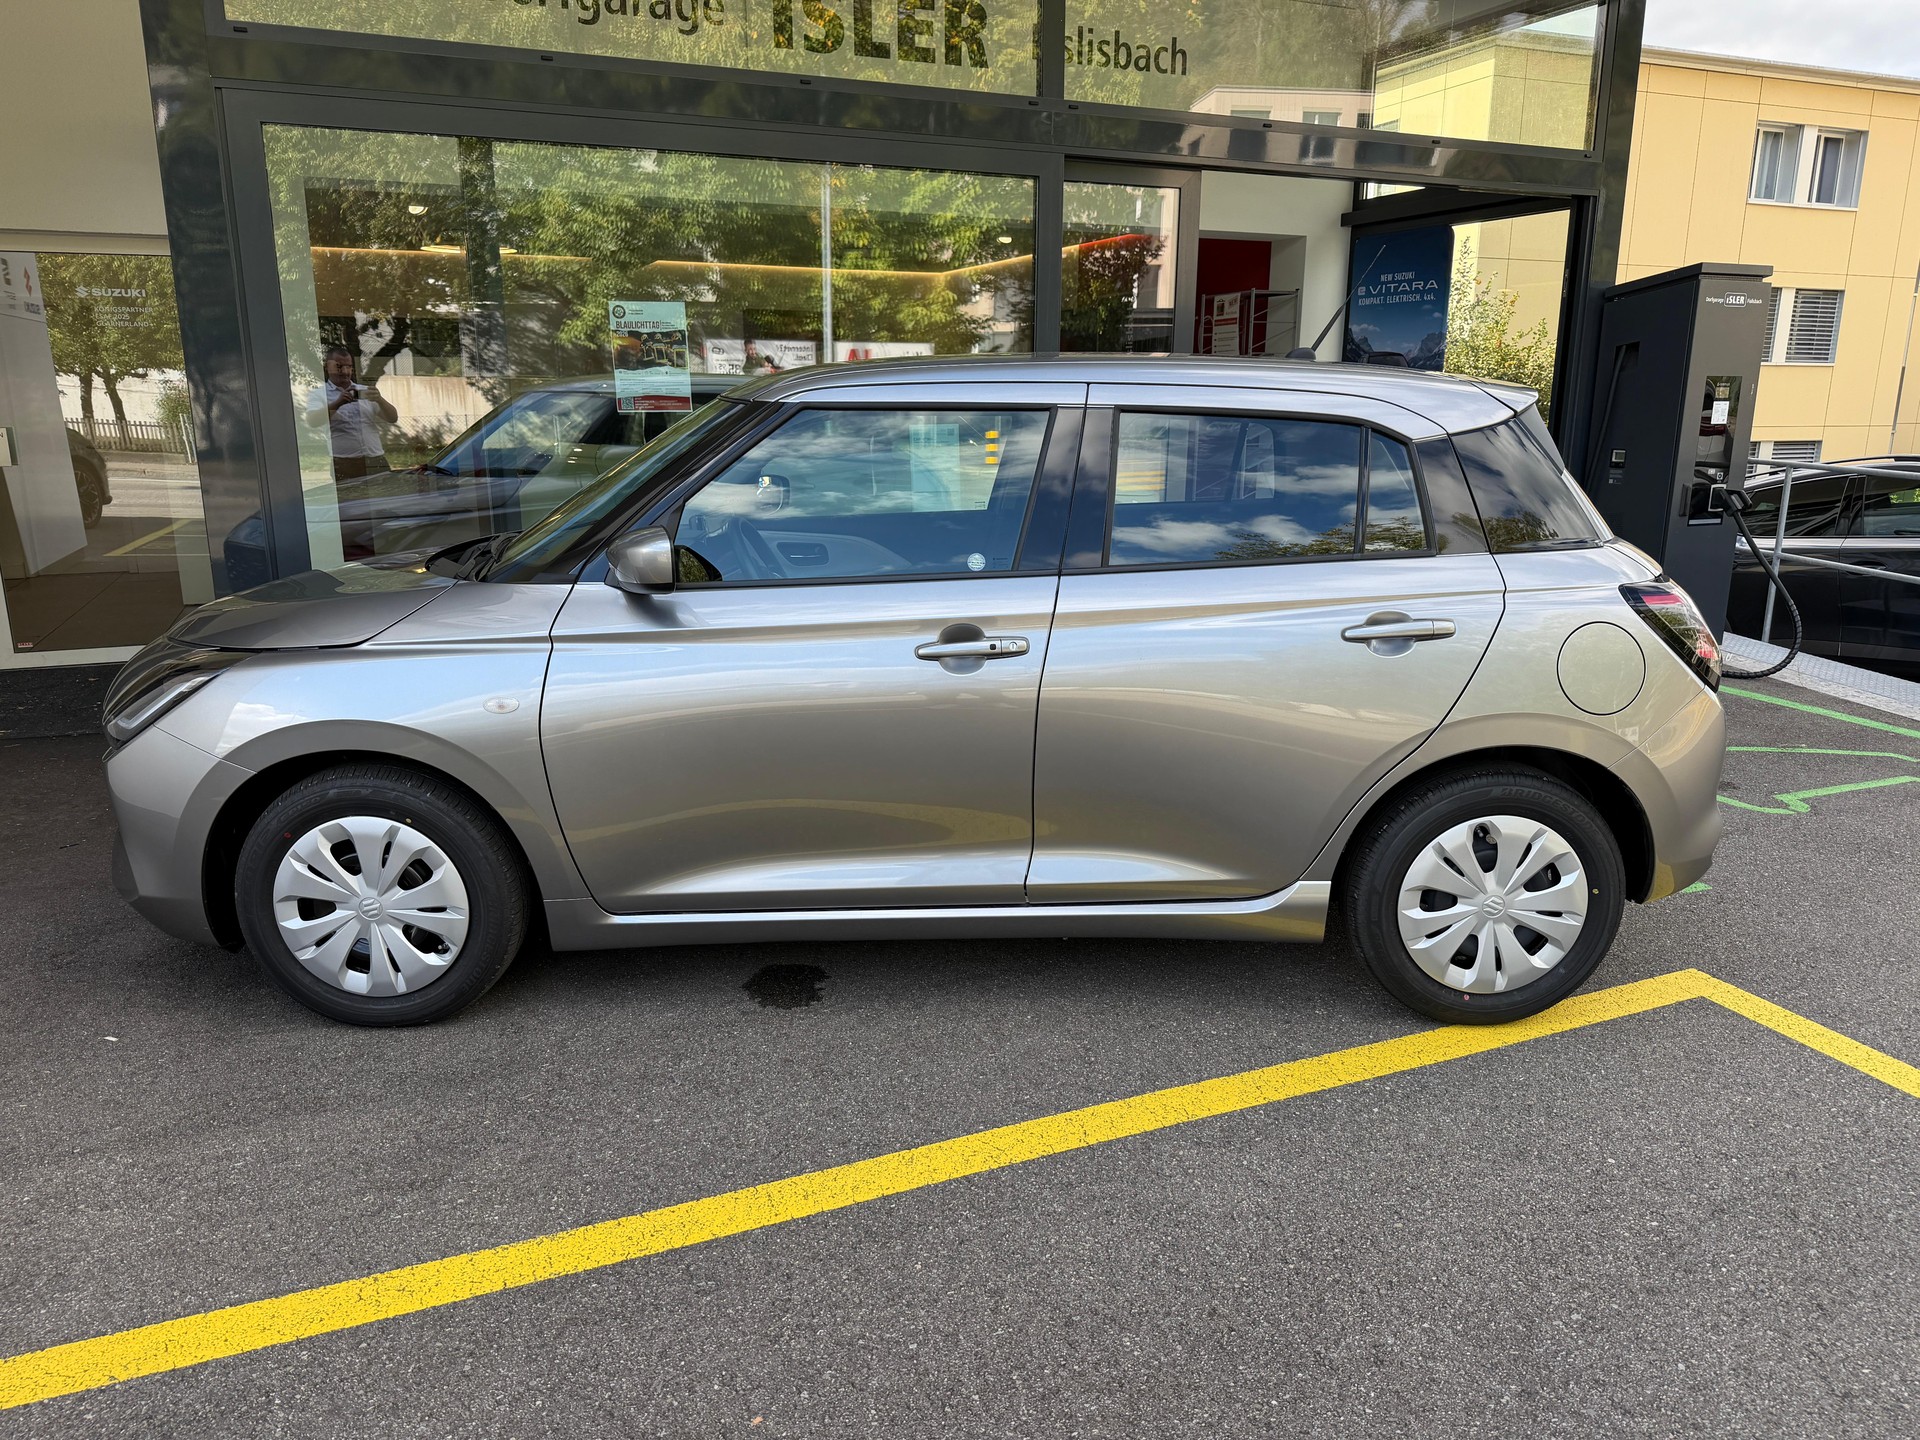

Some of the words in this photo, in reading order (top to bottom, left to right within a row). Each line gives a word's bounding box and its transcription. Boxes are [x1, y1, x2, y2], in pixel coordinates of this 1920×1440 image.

[1380, 273, 1393, 282] NEW
[1394, 271, 1416, 281] SUZUKI
[1369, 279, 1439, 294] VITARA
[91, 287, 147, 297] SUZUKI
[615, 320, 660, 330] BLAULICHTTAG
